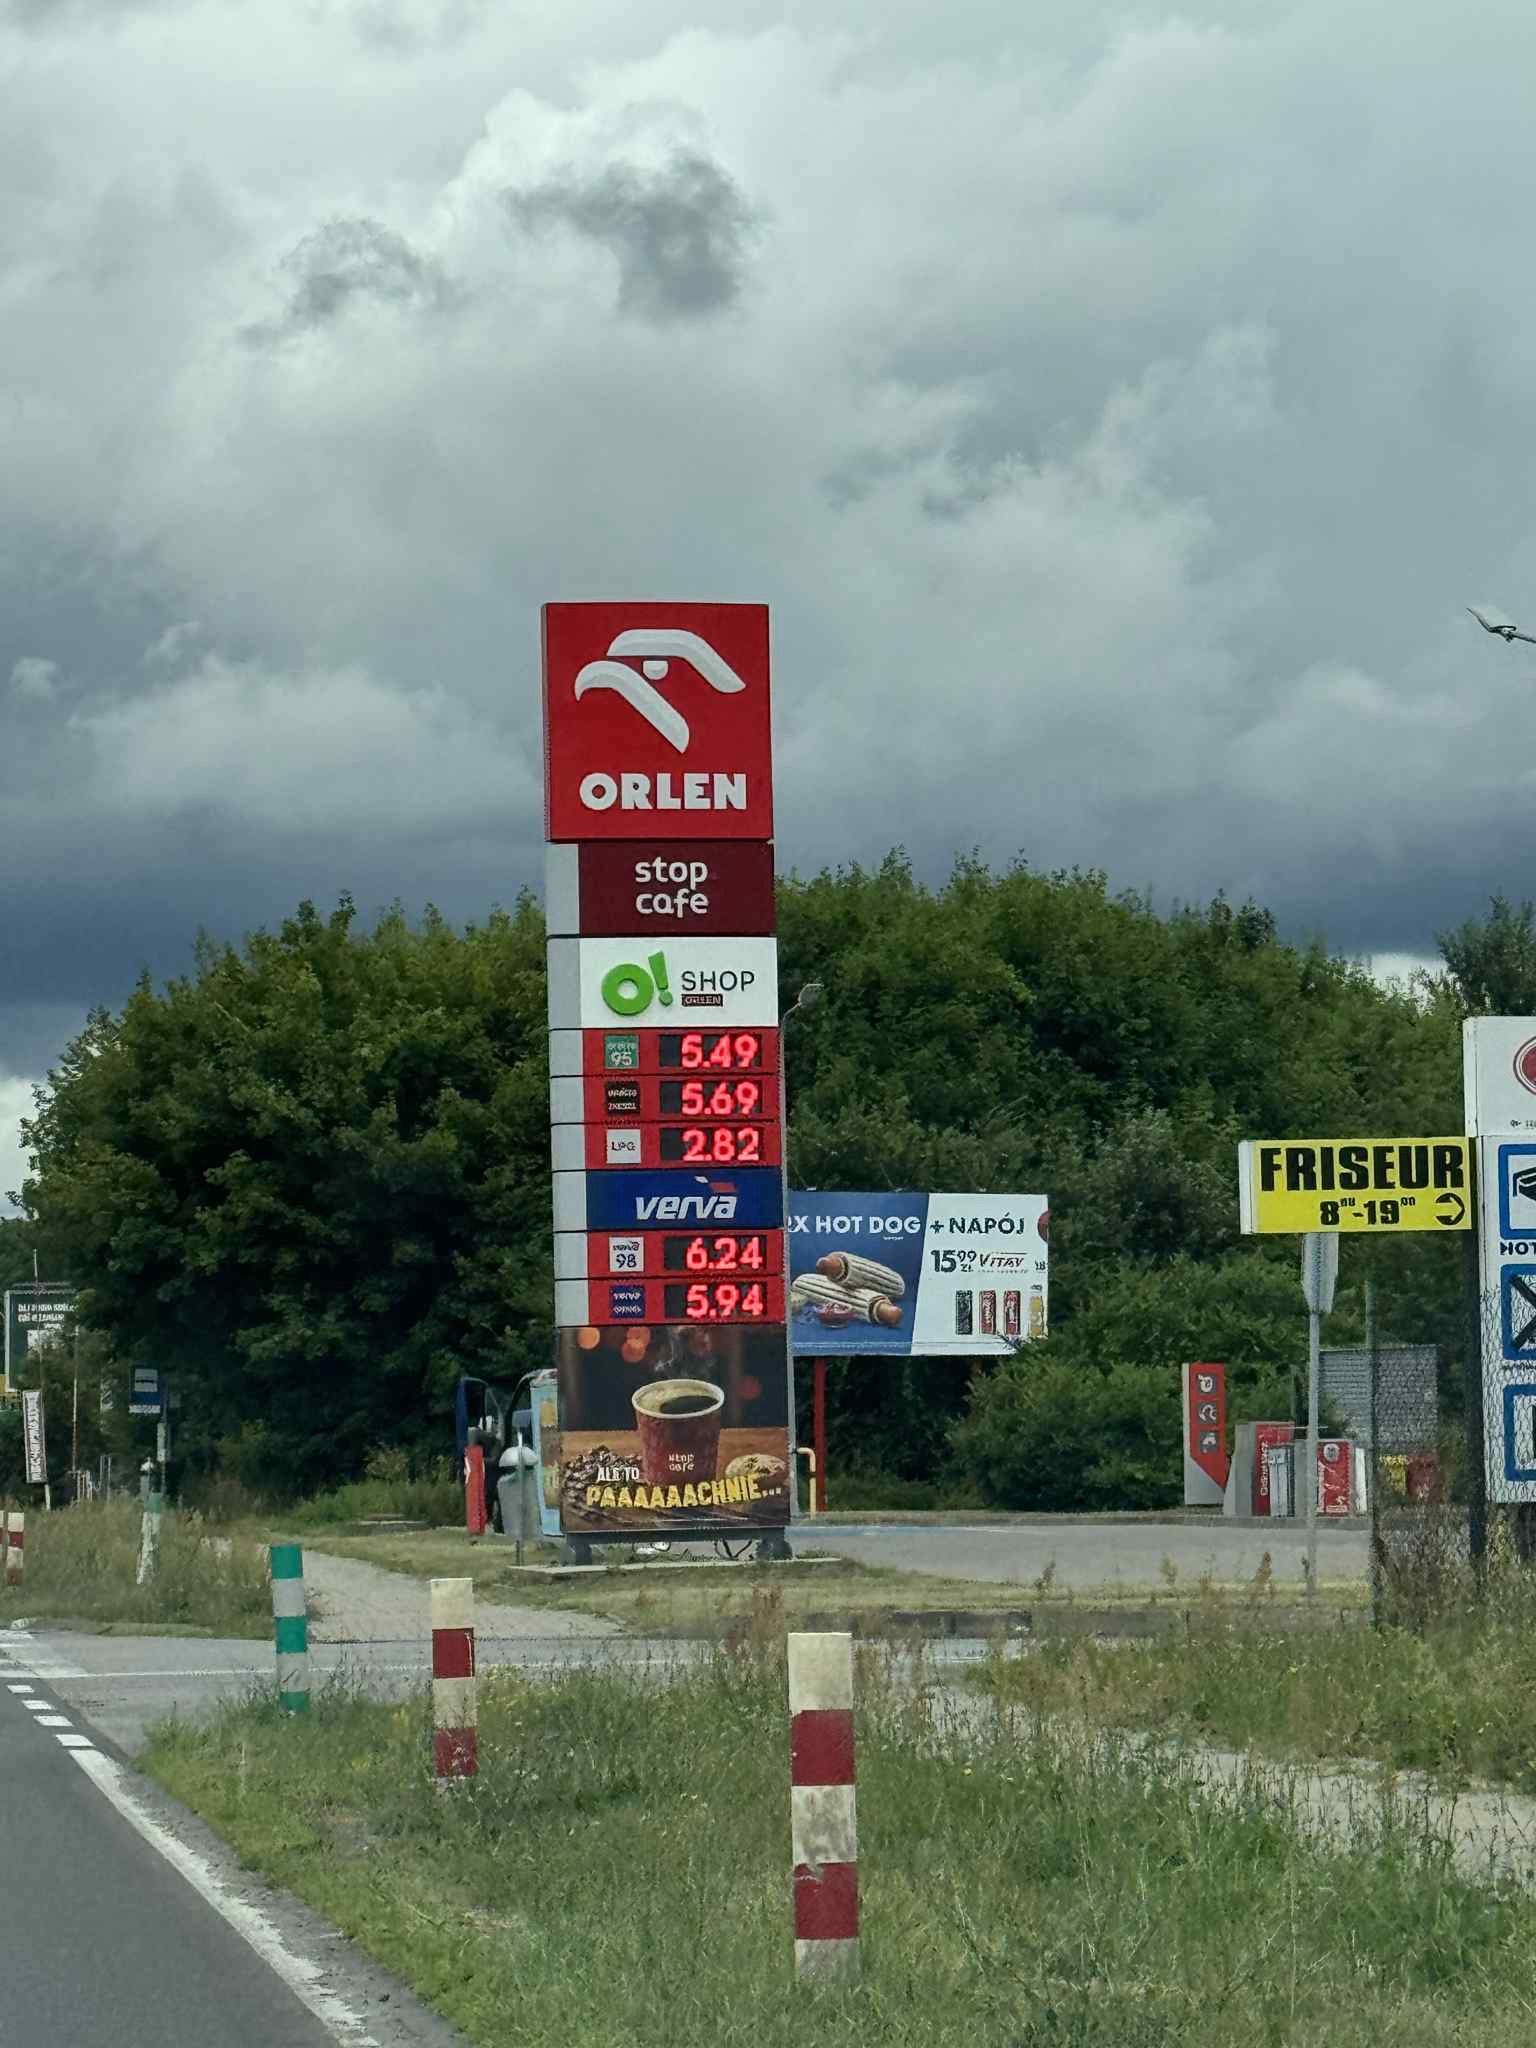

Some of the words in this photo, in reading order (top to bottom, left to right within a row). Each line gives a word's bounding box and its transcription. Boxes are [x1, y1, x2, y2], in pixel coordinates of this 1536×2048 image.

[579, 772, 747, 811] ORLEN
[635, 857, 709, 890] stop
[635, 889, 709, 918] cafe
[681, 970, 755, 992] SHOP
[681, 1034, 759, 1068] 5.49
[681, 1081, 760, 1116] 5.69
[611, 1141, 636, 1152] LPG
[682, 1127, 760, 1161] 2.82
[1260, 1145, 1464, 1191] FRISEUR
[815, 1215, 863, 1234] HOT
[869, 1215, 921, 1234] DOG
[949, 1212, 1025, 1235] NAPÓJ
[616, 1253, 637, 1269] 98
[686, 1236, 763, 1270] 6.24
[686, 1284, 764, 1318] 5.94
[623, 1466, 640, 1481] TO
